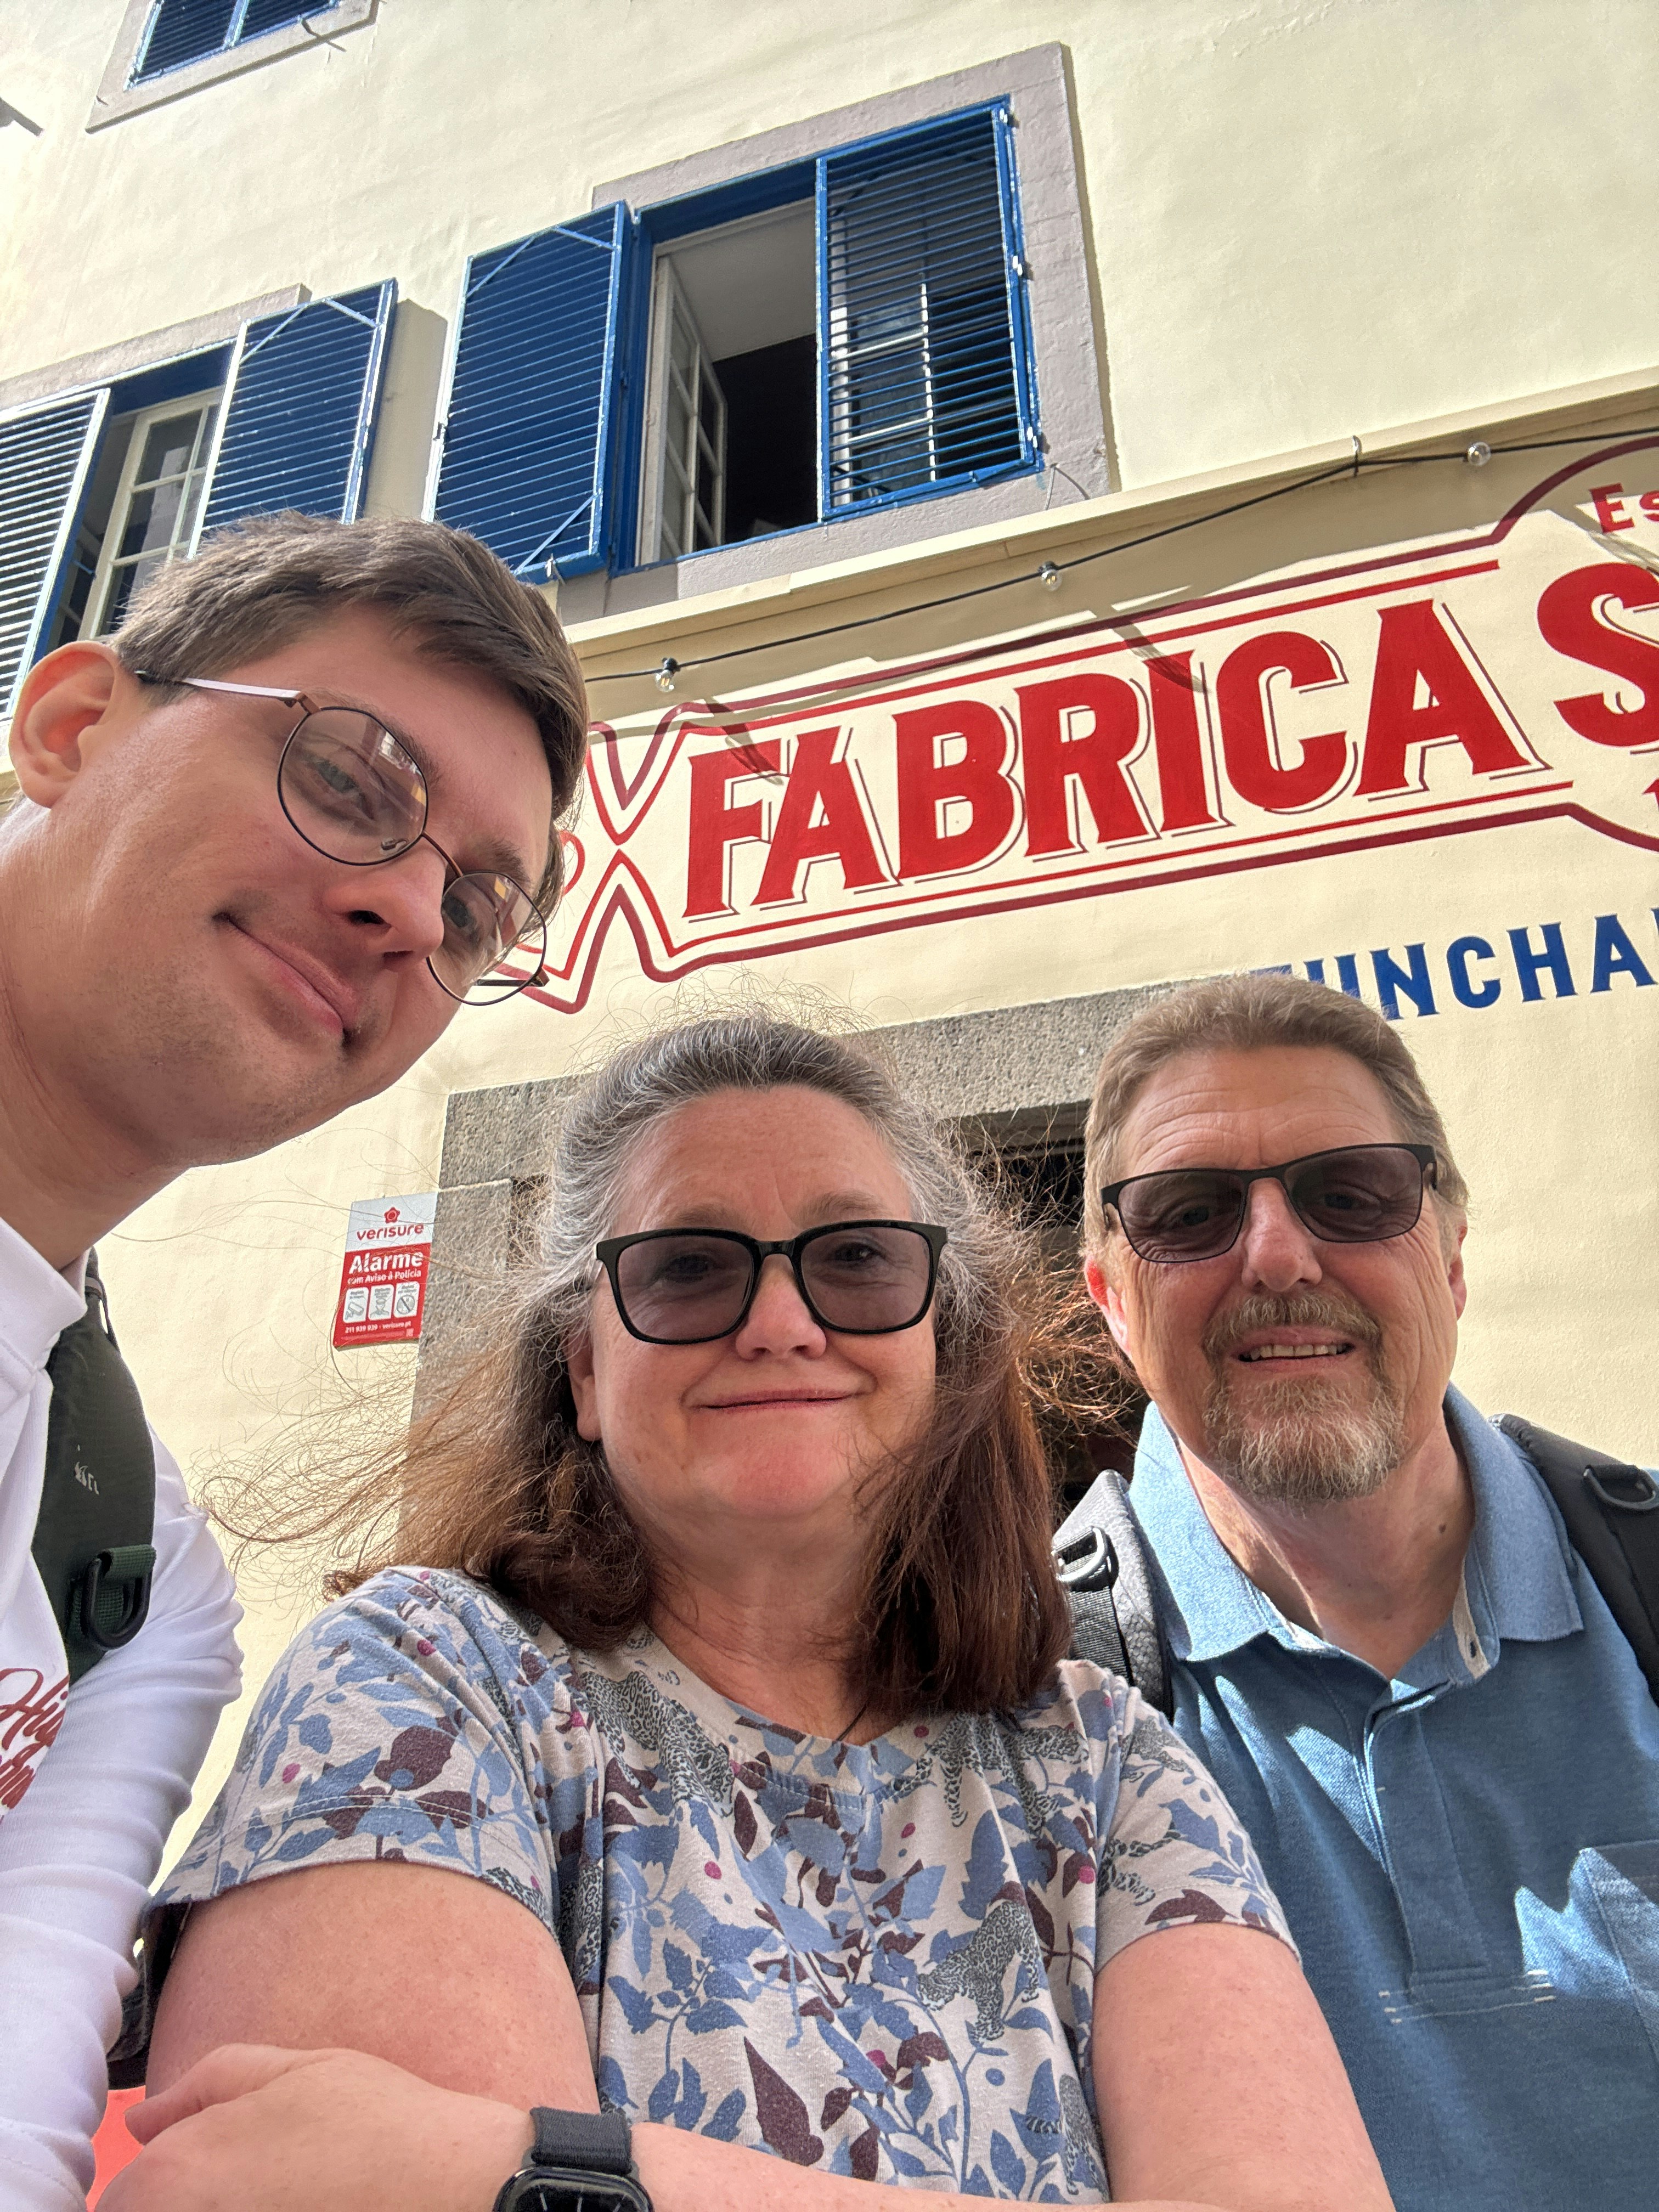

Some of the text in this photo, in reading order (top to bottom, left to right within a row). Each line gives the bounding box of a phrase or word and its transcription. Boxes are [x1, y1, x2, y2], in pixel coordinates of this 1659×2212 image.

[357, 1223, 424, 1240] verisure
[348, 1251, 423, 1274] Alarme
[347, 1276, 364, 1284] com
[365, 1273, 386, 1283] Aviso
